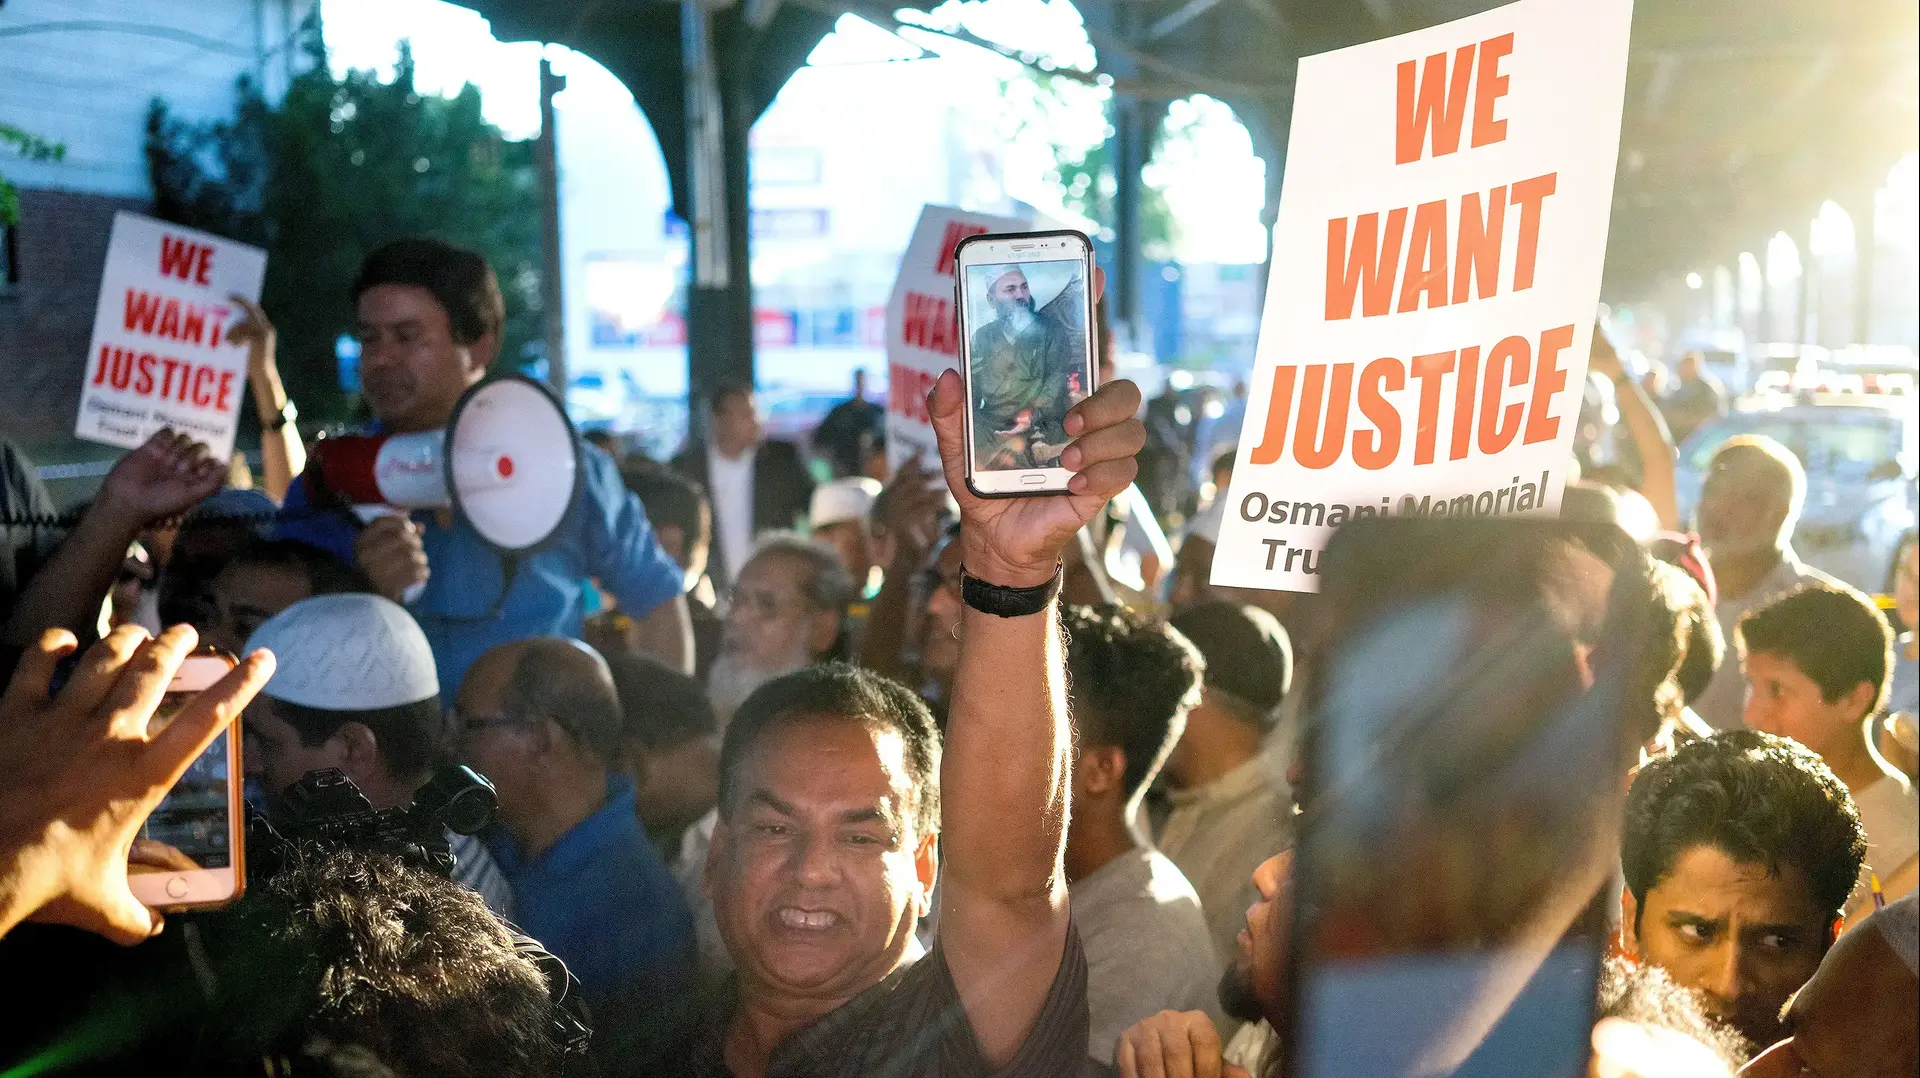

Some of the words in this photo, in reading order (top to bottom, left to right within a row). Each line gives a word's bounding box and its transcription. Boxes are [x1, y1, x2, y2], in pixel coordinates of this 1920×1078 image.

[1396, 31, 1515, 165] WE
[160, 234, 215, 286] WE
[1324, 172, 1557, 321] WANT
[123, 287, 230, 348] WANT
[903, 290, 958, 358] WA
[93, 343, 236, 412] JUSTICE
[1249, 324, 1575, 471] JUSTICE
[1239, 490, 1390, 528] Osmani
[1403, 470, 1550, 520] Memorial
[1261, 538, 1321, 576] Tru
